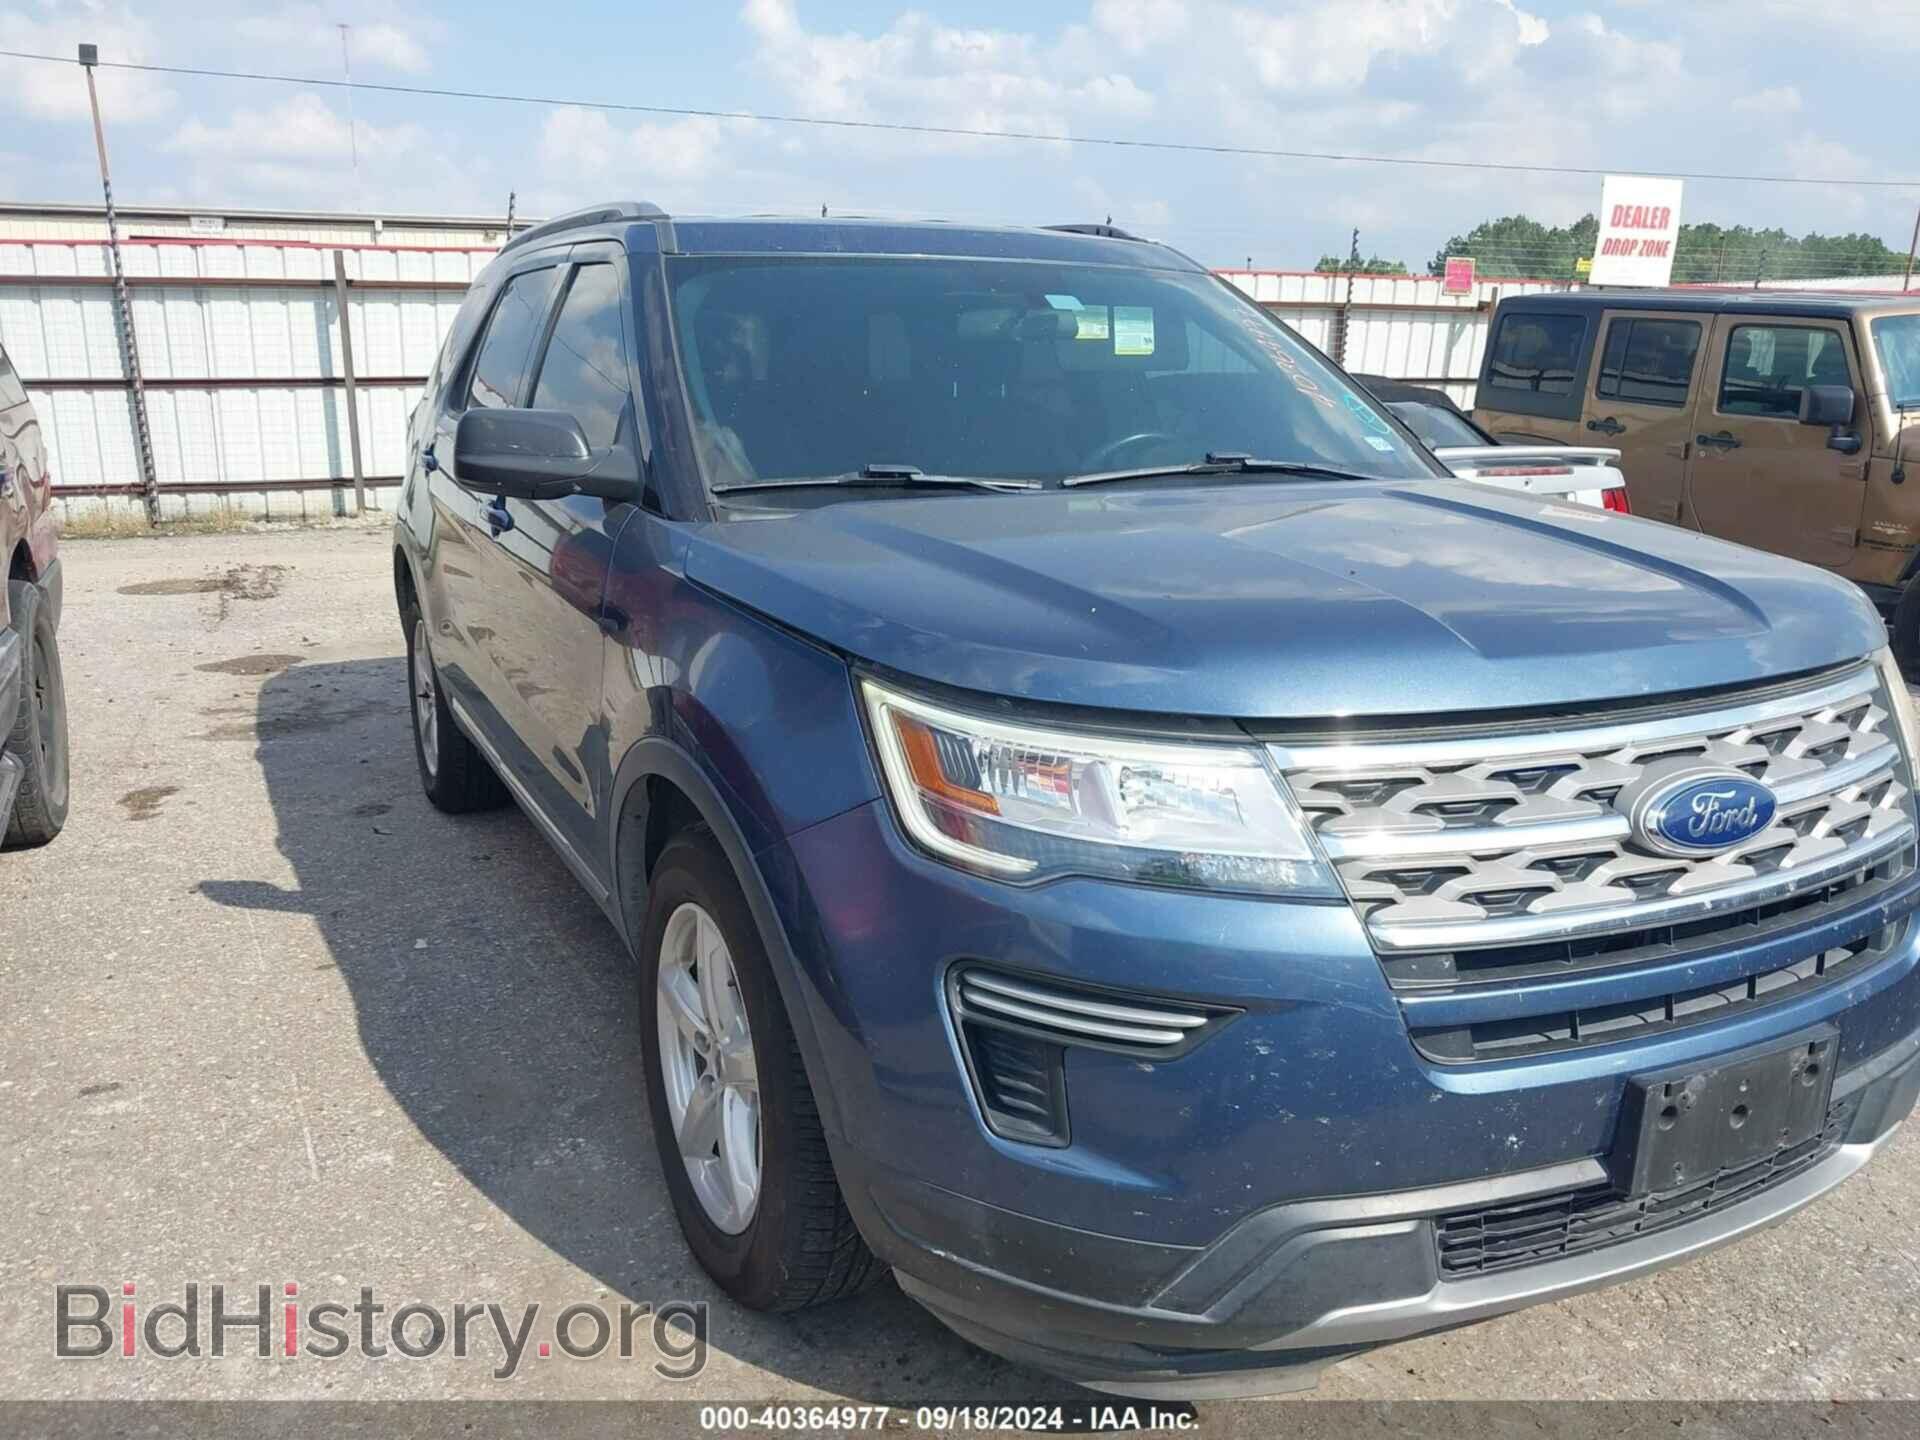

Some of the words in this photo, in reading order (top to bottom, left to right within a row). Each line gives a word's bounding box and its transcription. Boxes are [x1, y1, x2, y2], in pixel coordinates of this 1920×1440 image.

[1610, 204, 1671, 230] DEALER
[1601, 237, 1638, 257] DROP
[1638, 240, 1671, 258] ZONE
[1688, 790, 1757, 837] Ford
